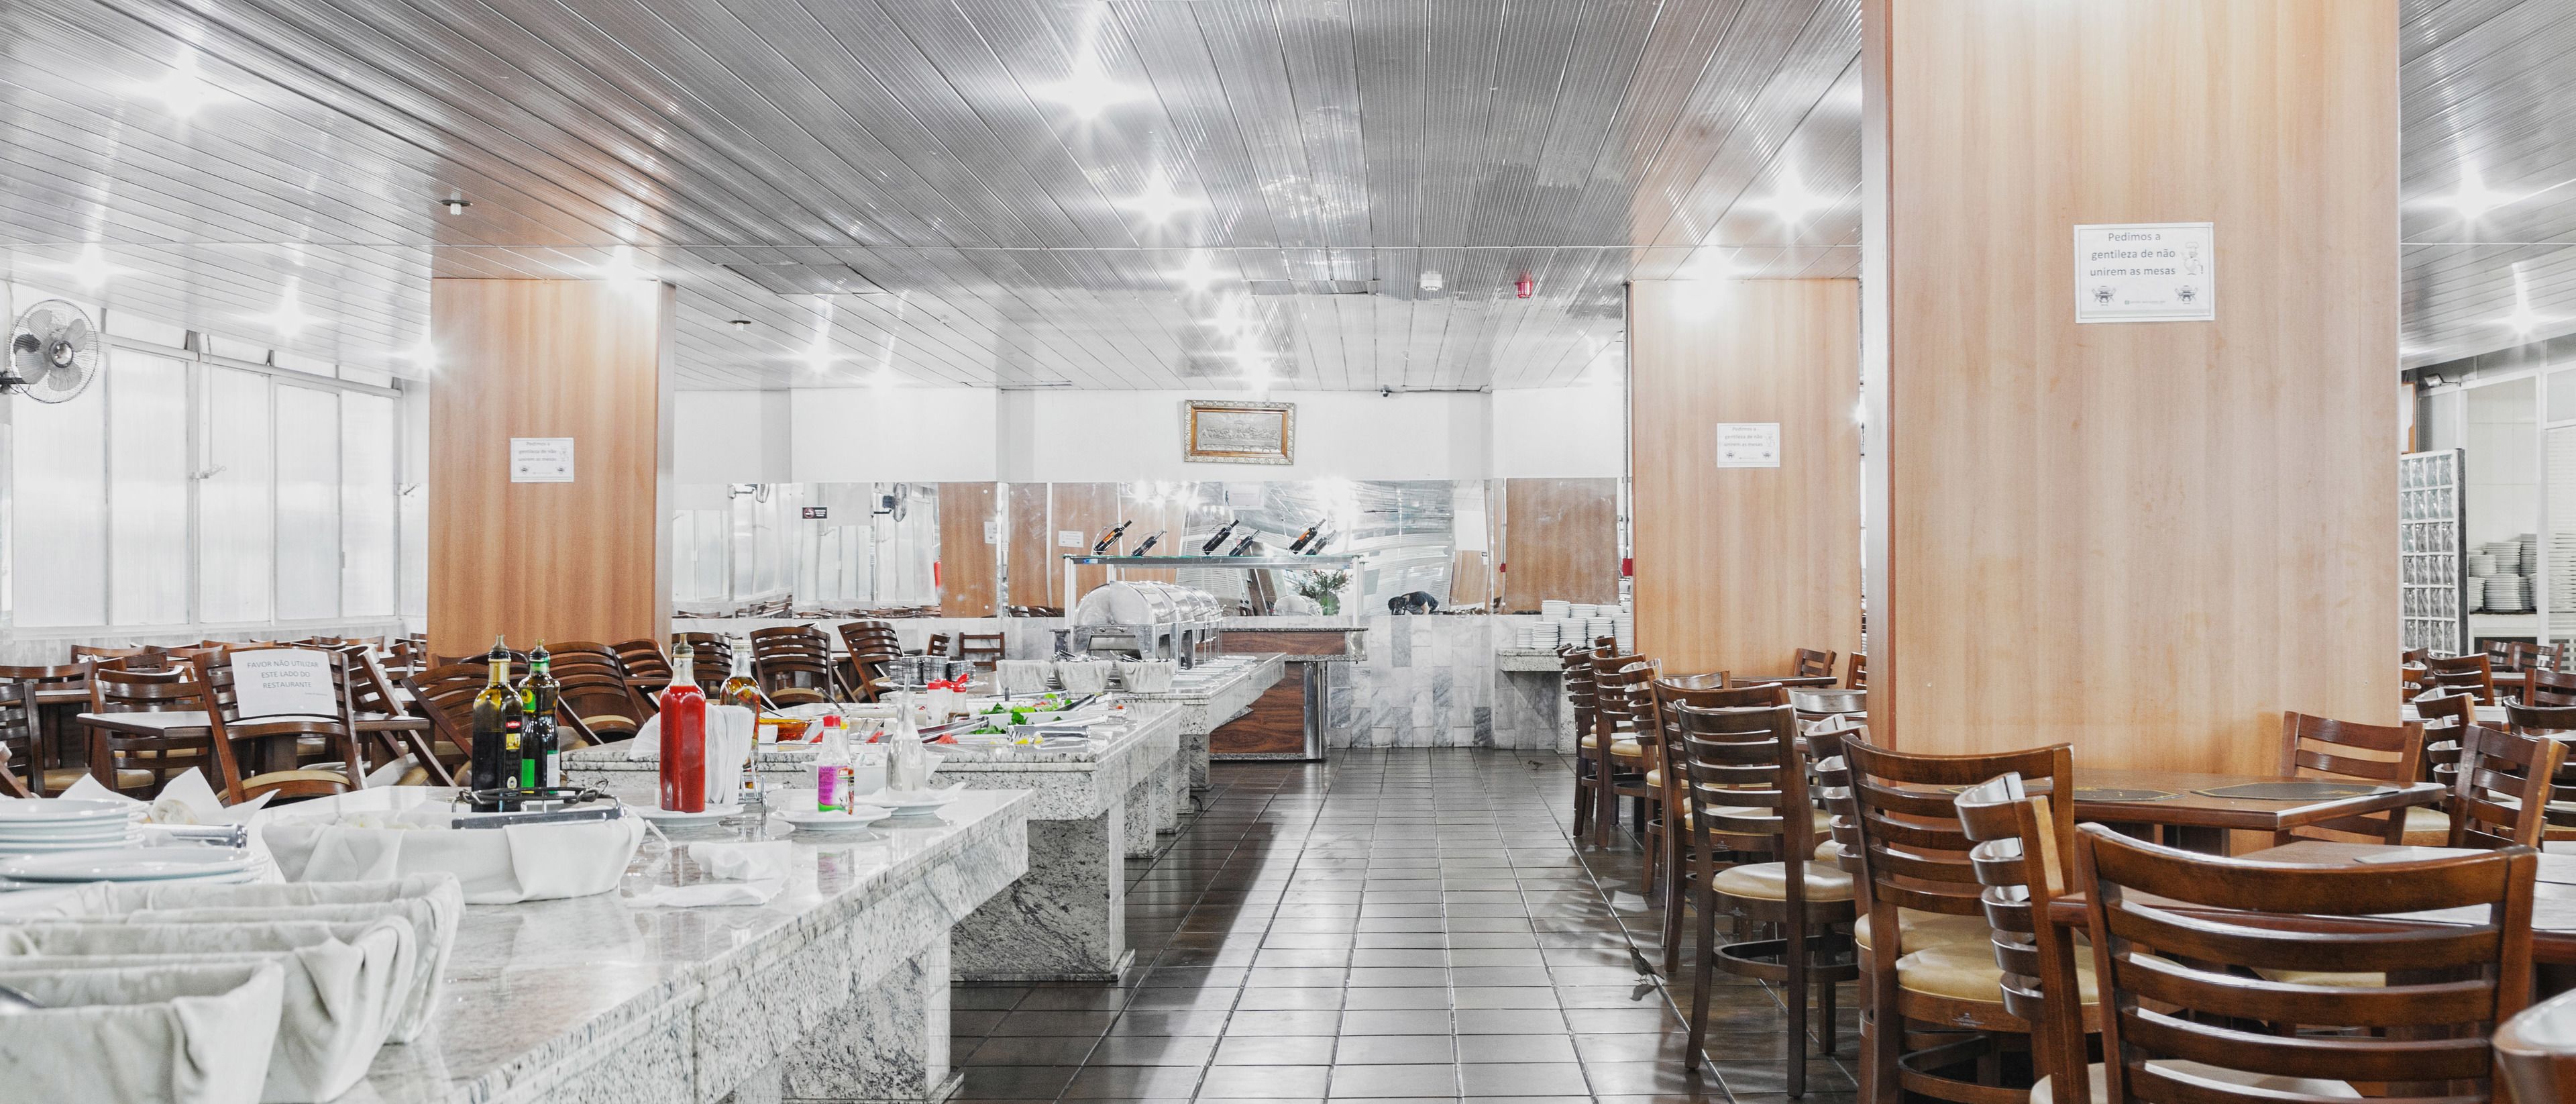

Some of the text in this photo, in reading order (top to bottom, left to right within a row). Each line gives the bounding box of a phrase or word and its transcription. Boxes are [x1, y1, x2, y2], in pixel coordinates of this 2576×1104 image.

[2108, 232, 2152, 242] Pedimos
[2091, 248, 2176, 261] gentileza de não
[2090, 267, 2127, 276] unirem
[247, 660, 272, 668] FAVOR
